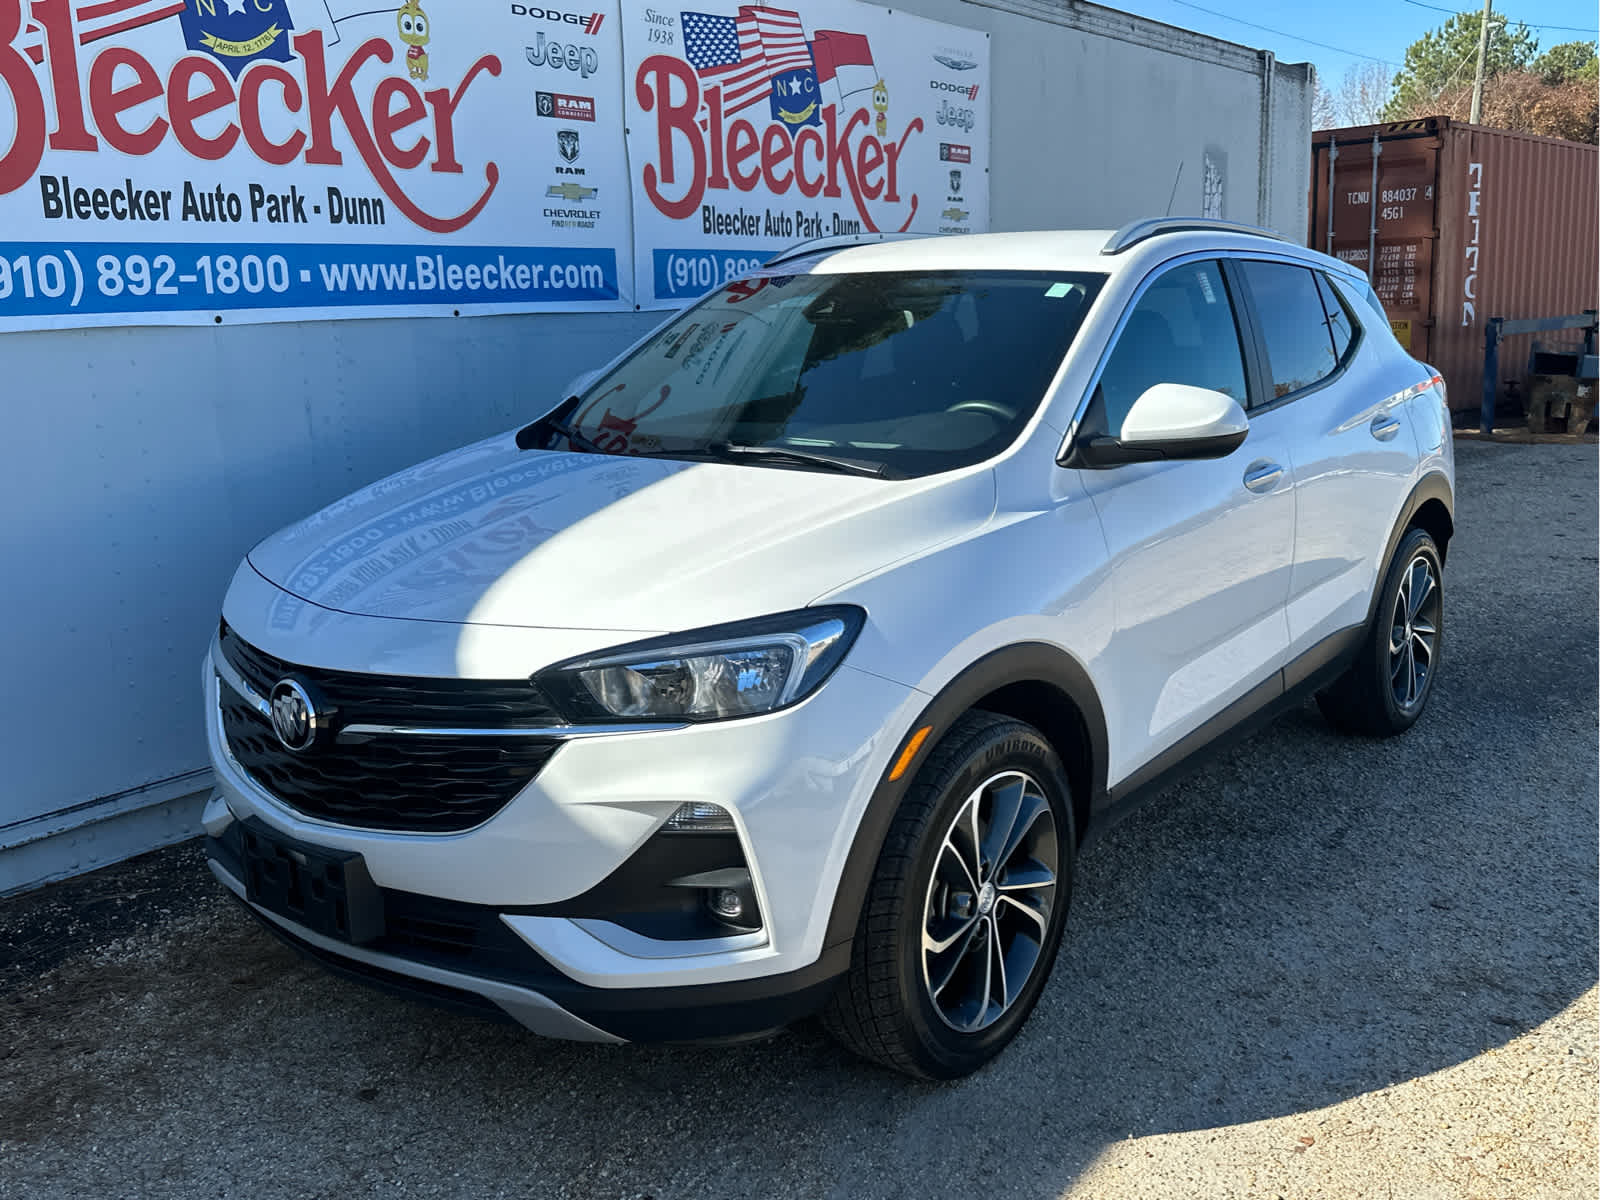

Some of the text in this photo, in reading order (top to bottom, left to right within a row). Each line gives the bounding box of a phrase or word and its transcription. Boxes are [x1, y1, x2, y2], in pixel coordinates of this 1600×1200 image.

[511, 4, 593, 26] DODGE
[645, 8, 674, 27] Since
[647, 28, 674, 45] 1938
[525, 31, 598, 79] Jeep
[776, 76, 814, 97] N C
[930, 80, 973, 95] DODGE
[557, 98, 592, 110] RAM
[936, 99, 975, 134] Jeep
[634, 54, 924, 233] Bleecker
[555, 166, 586, 176] RAM
[40, 175, 386, 226] Bleecker Auto Park Dunn
[1347, 191, 1370, 205] TCNU
[1382, 187, 1417, 203] 884037
[543, 208, 601, 219] CHEVROLET
[702, 204, 860, 238] Bleecker Auto Park Dunn
[1382, 206, 1404, 220] 45G1
[96, 254, 290, 296] 892-1800
[319, 254, 604, 292] www.Bleecker.com
[667, 254, 719, 293] (910)
